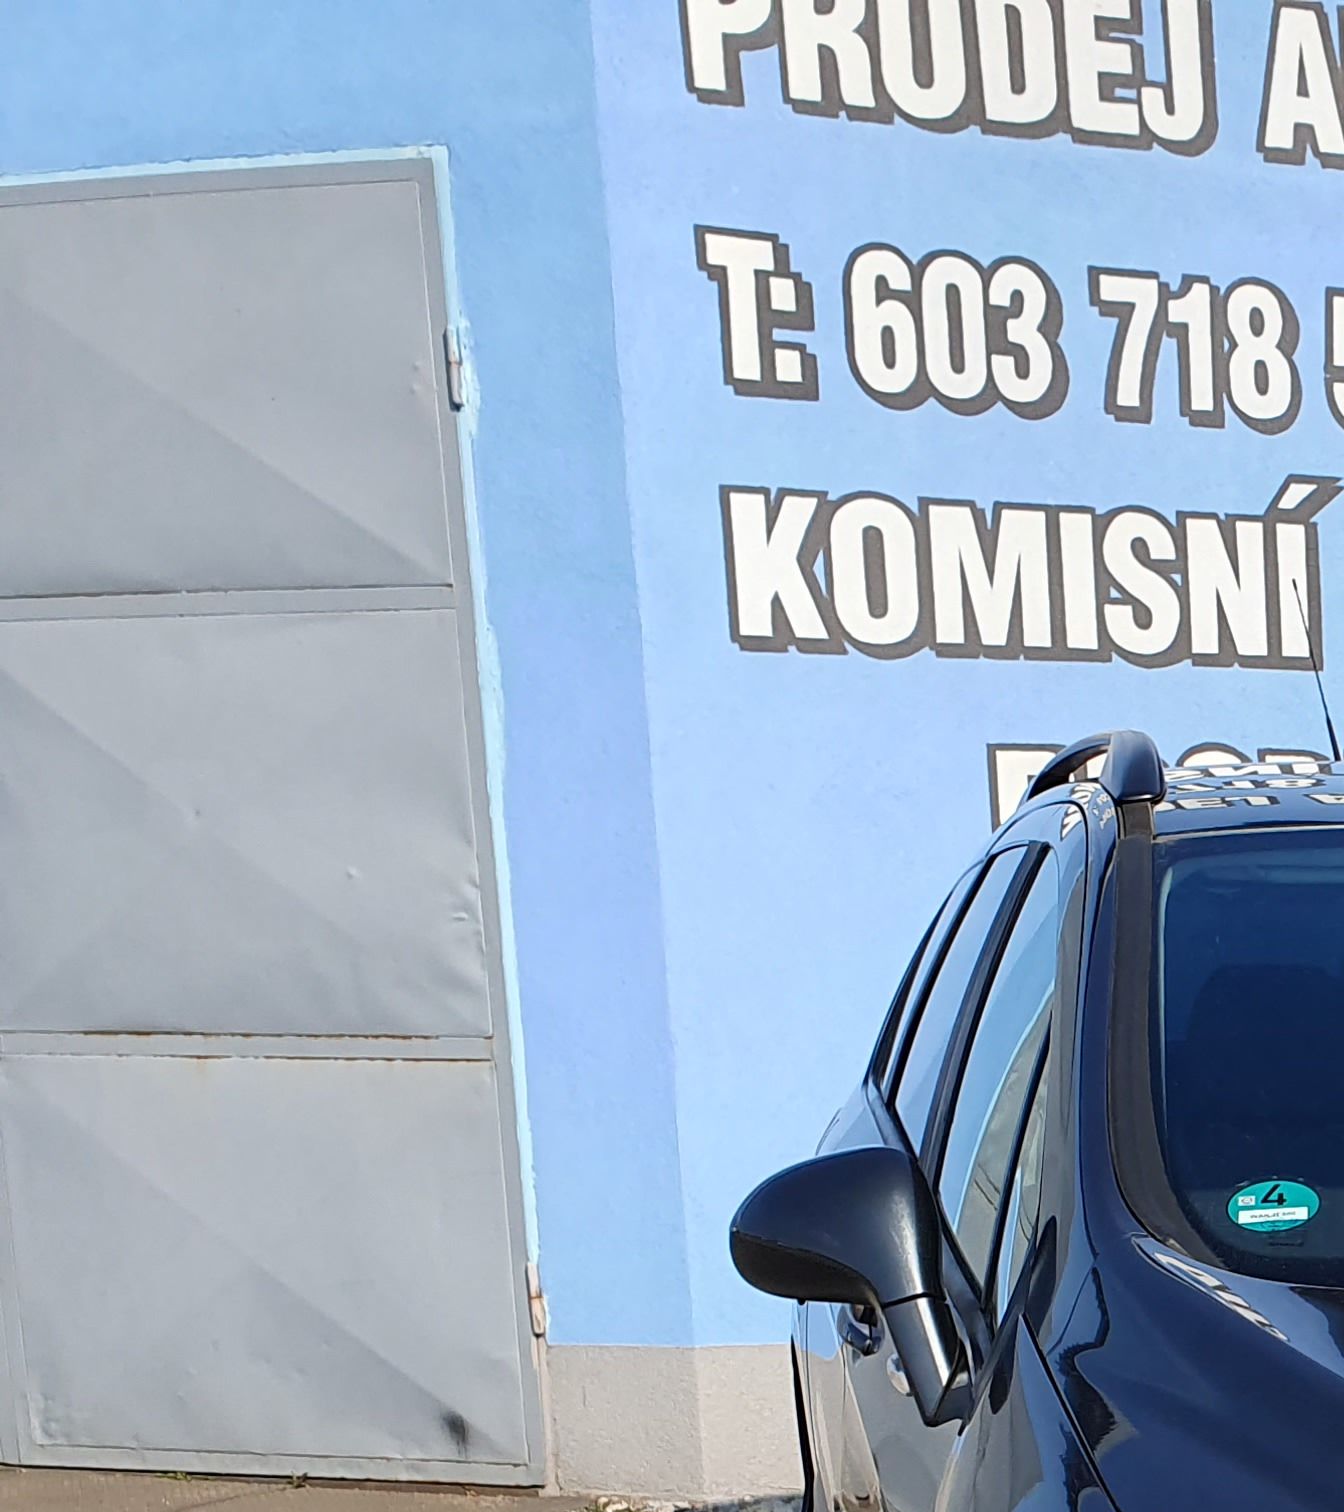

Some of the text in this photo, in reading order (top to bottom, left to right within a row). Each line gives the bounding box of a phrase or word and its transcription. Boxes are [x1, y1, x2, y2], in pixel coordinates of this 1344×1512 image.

[678, 0, 1219, 157] PRODEJ
[695, 224, 820, 402] T:
[842, 242, 1070, 420] 603
[1087, 265, 1307, 437] 718
[719, 475, 1344, 671] KOMISNÍ
[1260, 1183, 1287, 1206] 4
